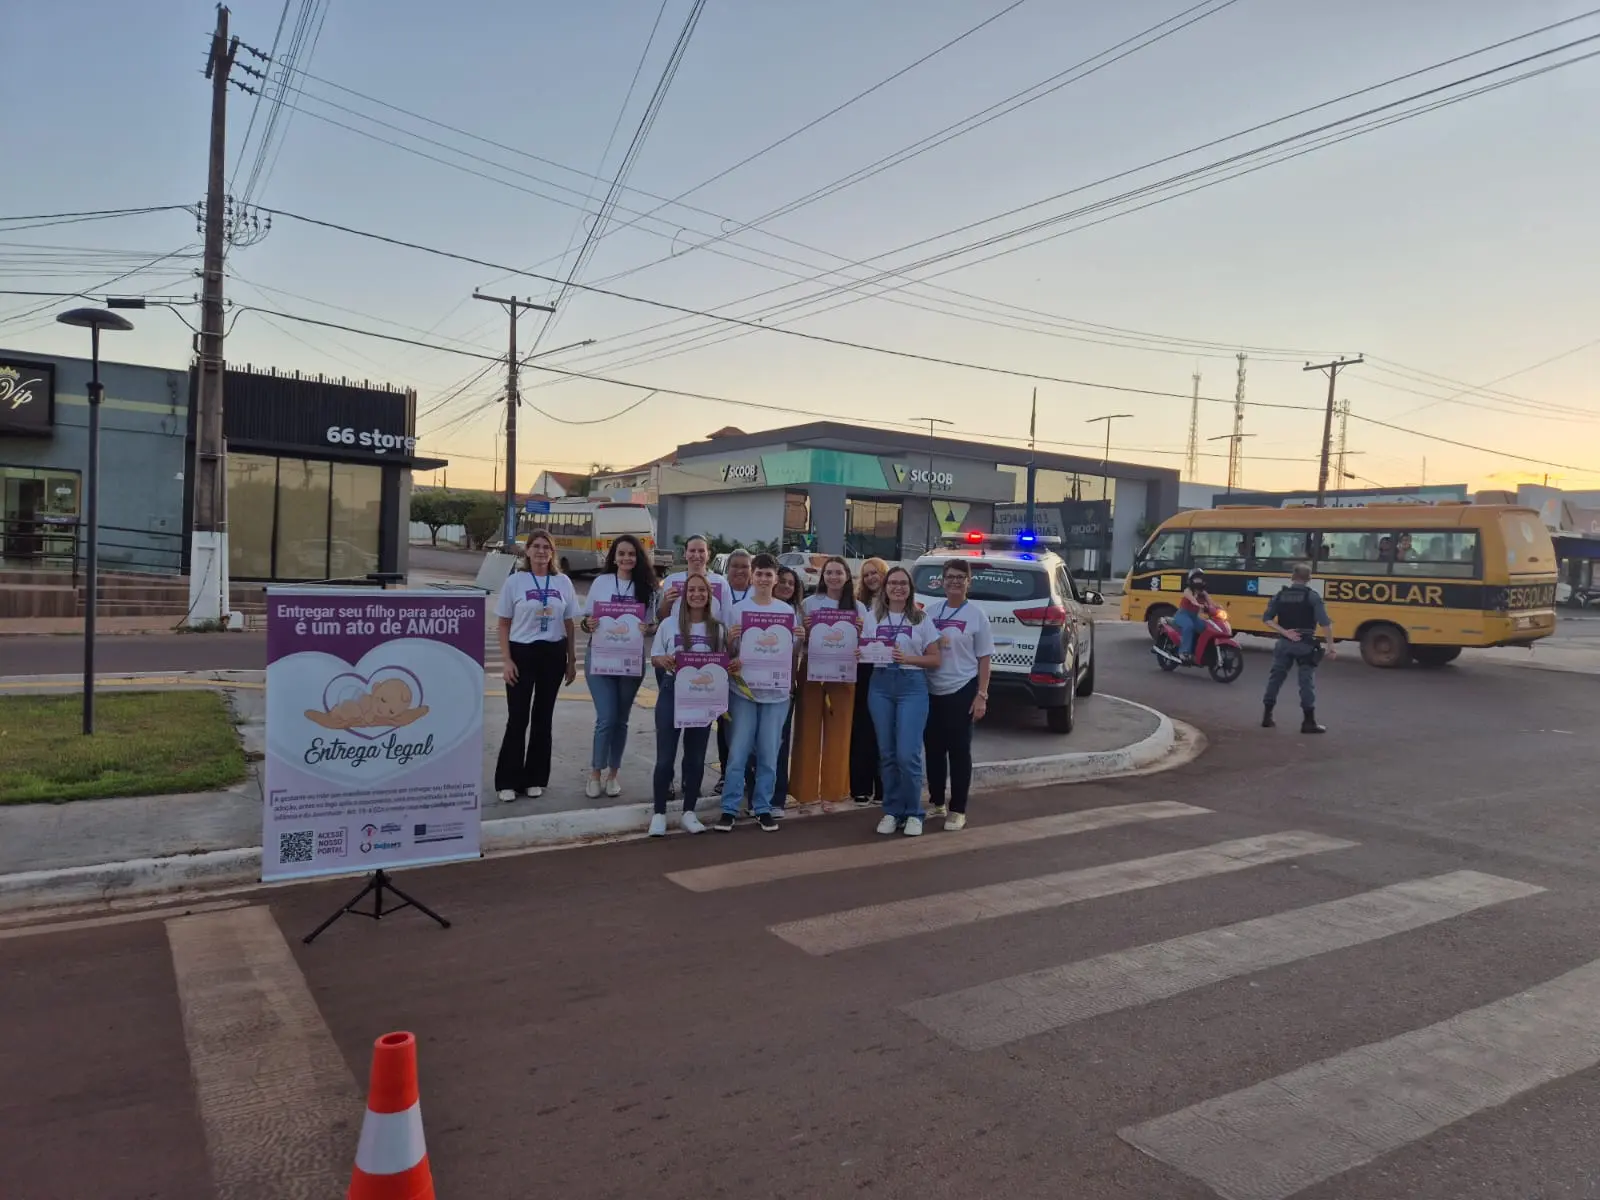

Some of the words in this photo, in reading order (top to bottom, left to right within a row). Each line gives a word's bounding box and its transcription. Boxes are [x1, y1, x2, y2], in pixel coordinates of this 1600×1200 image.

[0, 378, 42, 409] Vip
[326, 426, 355, 444] 66
[359, 428, 416, 449] store
[910, 469, 953, 485] SICOOB
[970, 575, 1023, 585] ATRULHA
[1324, 581, 1443, 605] ESCOLAR
[1508, 586, 1555, 608] ESCOLAR
[277, 604, 336, 621] Entregar
[338, 607, 362, 618] seu
[366, 604, 395, 618] filho
[399, 607, 427, 621] para
[430, 605, 476, 620] adoção
[295, 617, 307, 635] é
[312, 622, 341, 635] um
[346, 619, 375, 635] ato
[380, 618, 401, 635] de
[406, 618, 459, 635] AMOR
[304, 737, 381, 768] Entrega
[382, 733, 434, 765] Legal
[318, 830, 344, 839] ACESSE
[318, 838, 343, 847] NOSSO
[317, 847, 344, 855] PORTAL
